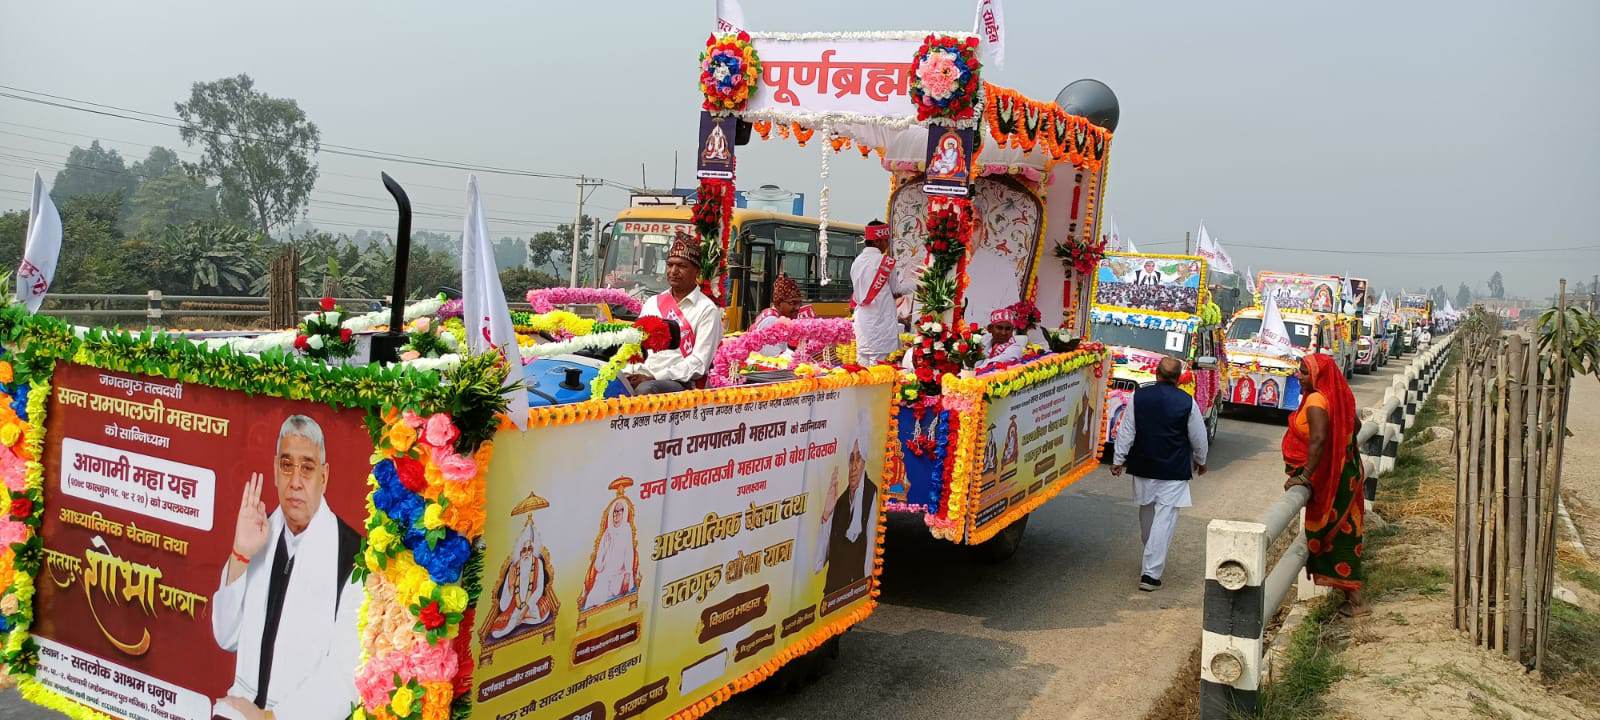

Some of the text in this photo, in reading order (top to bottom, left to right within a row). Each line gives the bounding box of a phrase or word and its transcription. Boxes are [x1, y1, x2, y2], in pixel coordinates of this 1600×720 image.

[763, 50, 912, 106] पूर्णब्रह्म
[1173, 337, 1177, 347] 1
[99, 374, 183, 399] जगतगुरु तत्वदर्शी
[58, 386, 230, 437] सन्त रामपालजी महाराज
[105, 423, 170, 449] को सान्निध्यमा
[654, 438, 682, 460] सन्त
[686, 422, 746, 454] रामपालजी
[749, 420, 786, 443] महाराज
[790, 423, 799, 435] को
[73, 452, 198, 500] आगामी महा यज्ञ
[639, 437, 838, 500] सन्त गरीबदासजी महाराज को बोध दिवसको
[150, 497, 161, 508] को
[59, 508, 189, 556] आध्यात्मिक चेतना तथा
[651, 492, 809, 561] आध्यात्मिक चेतना तथा
[661, 538, 795, 608] सतगुरु शोभा यात्रा
[159, 584, 208, 620] यात्रा
[709, 607, 735, 628] विशाल
[41, 645, 59, 660] स्थान
[71, 654, 112, 680] सतलोक
[113, 671, 145, 693] आश्रम
[147, 683, 178, 707] धनुषा
[520, 700, 536, 717] सबै
[539, 689, 564, 708] सादर
[619, 685, 664, 716] अखण्ड पाठ
